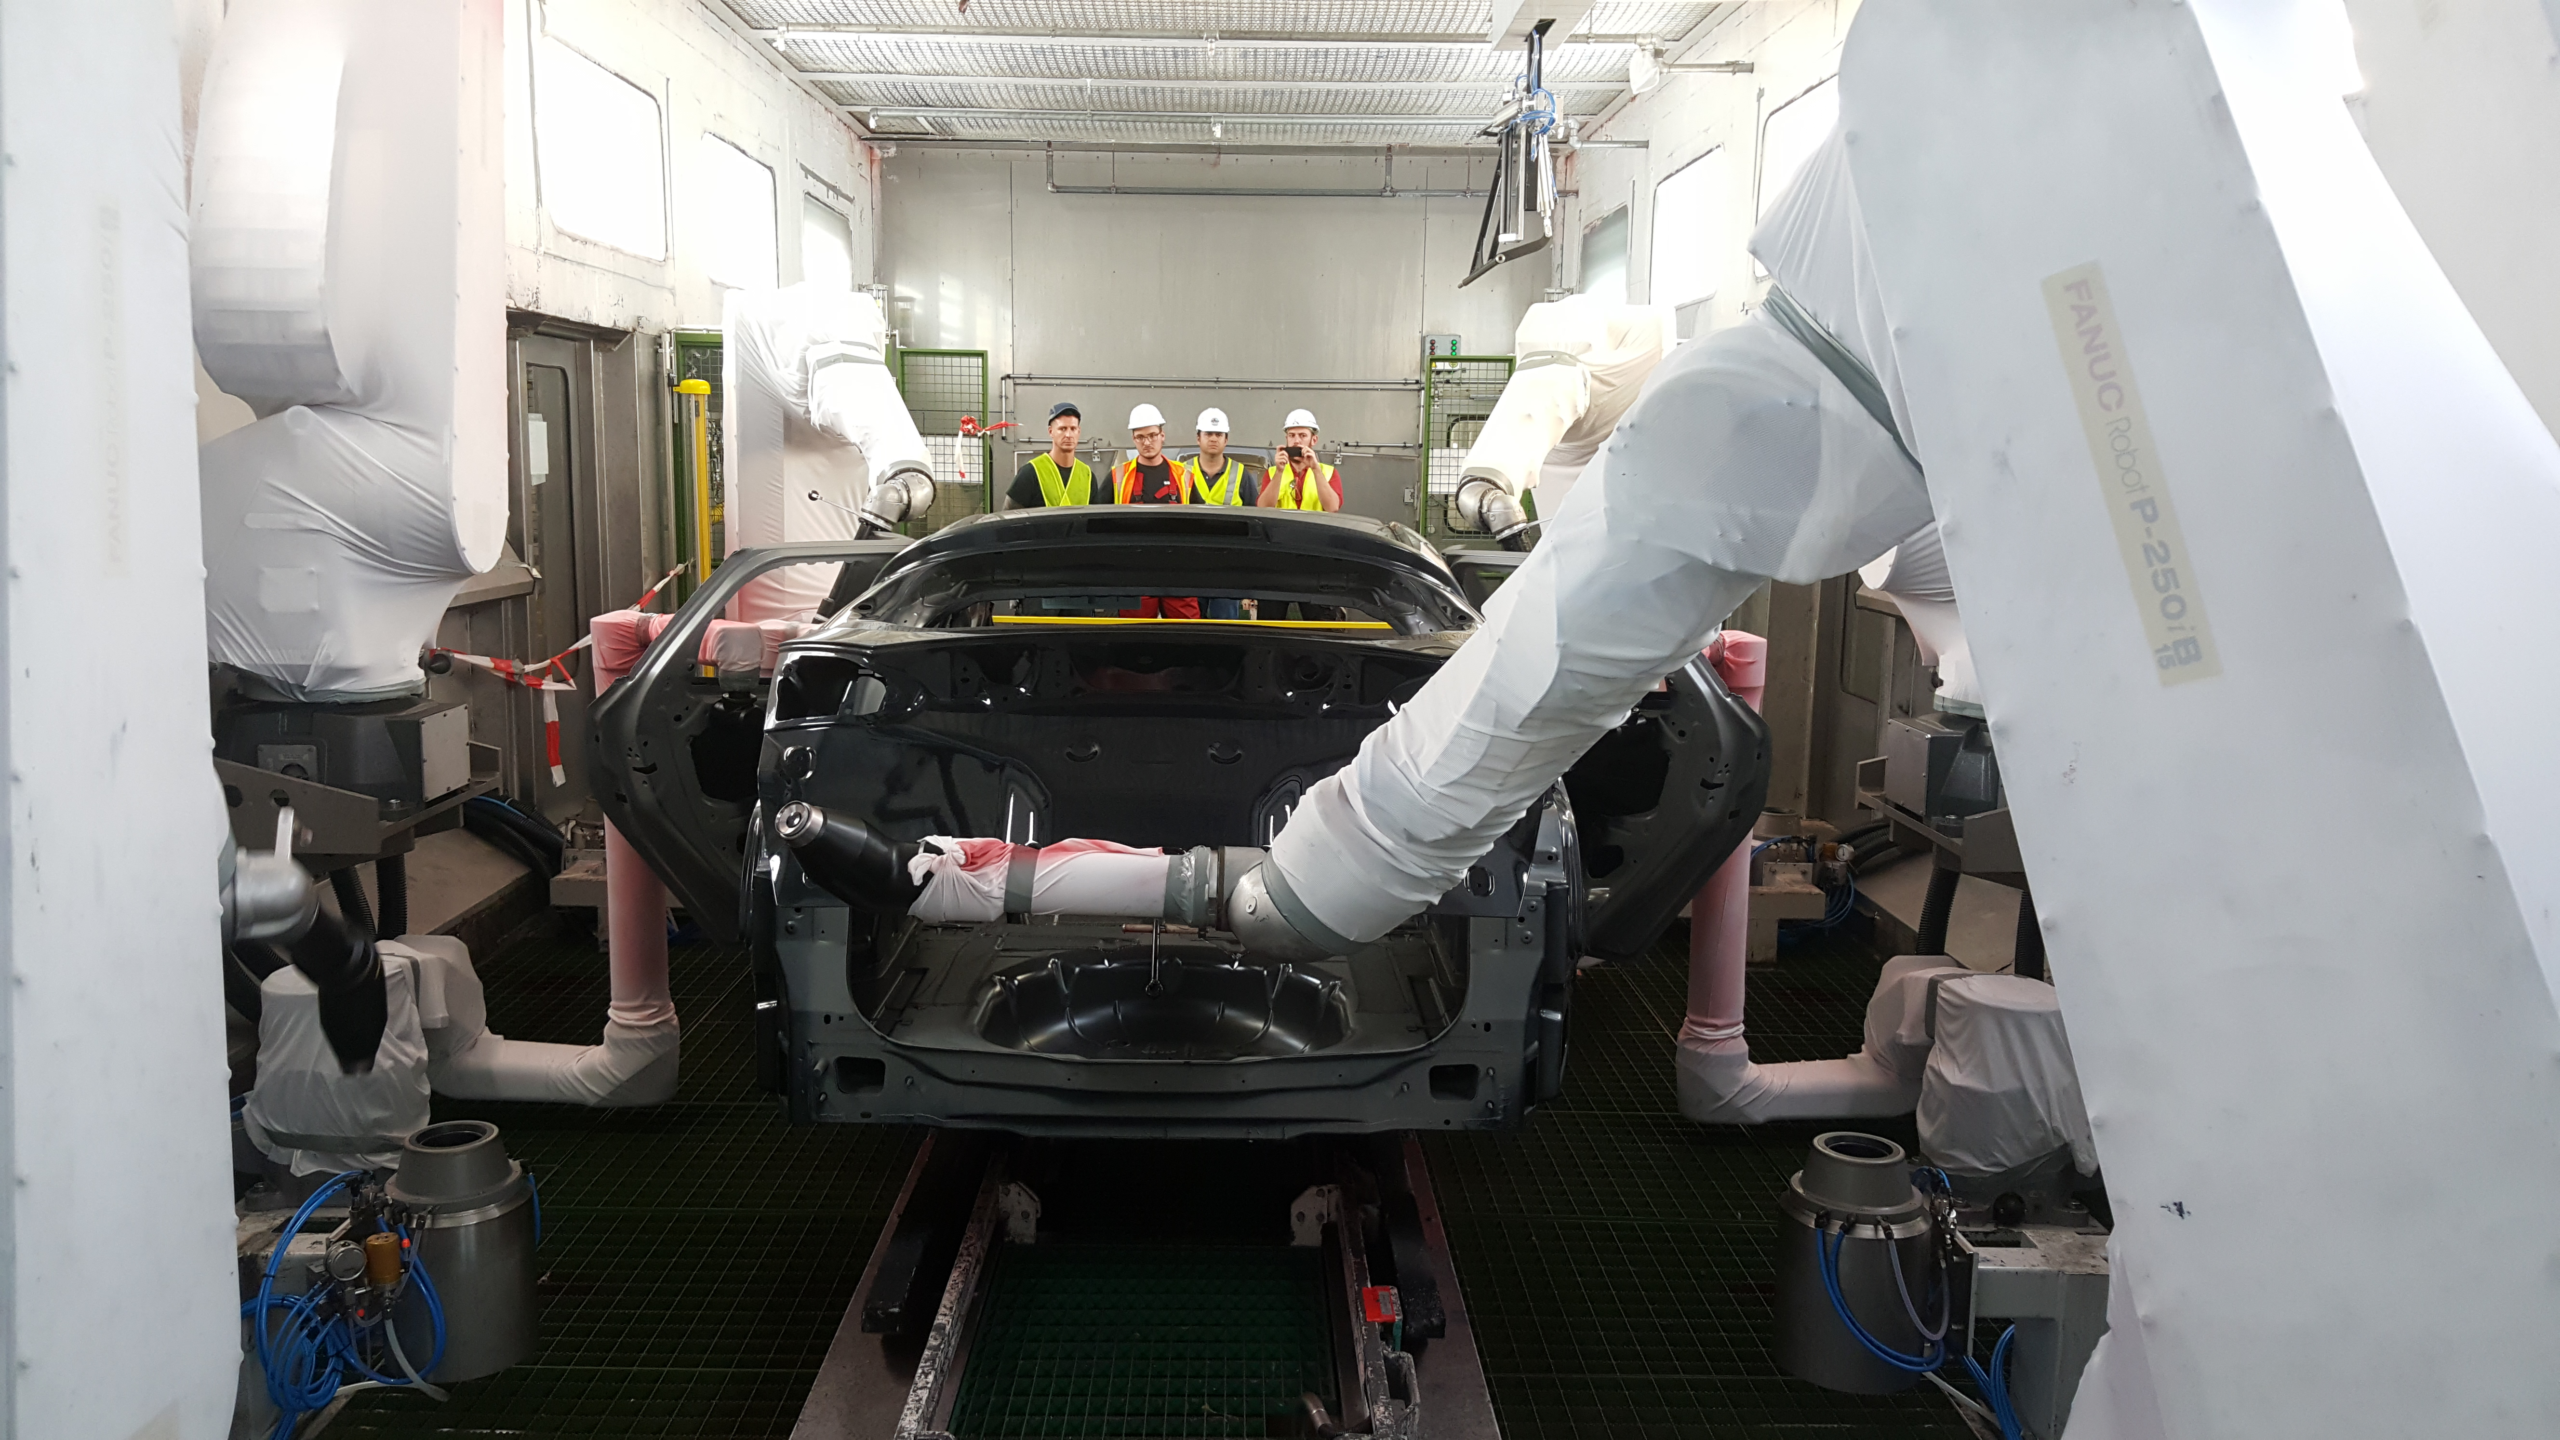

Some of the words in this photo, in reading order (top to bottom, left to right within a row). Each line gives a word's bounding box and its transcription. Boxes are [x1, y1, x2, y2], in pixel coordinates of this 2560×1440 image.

[2063, 278, 2125, 412] FANUC
[2105, 416, 2150, 496] Robot
[106, 443, 122, 564] FANUC
